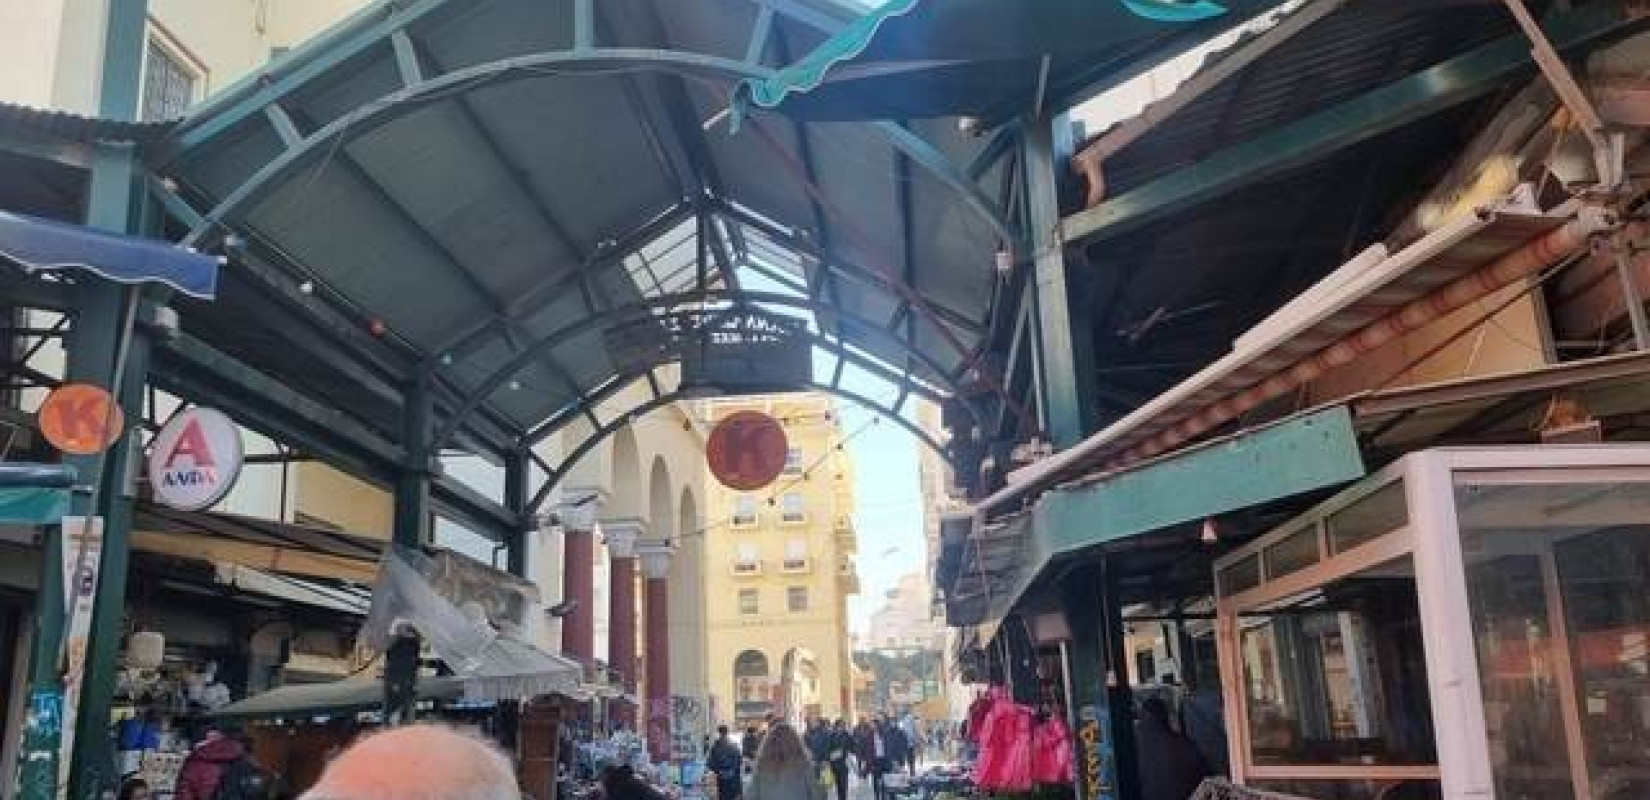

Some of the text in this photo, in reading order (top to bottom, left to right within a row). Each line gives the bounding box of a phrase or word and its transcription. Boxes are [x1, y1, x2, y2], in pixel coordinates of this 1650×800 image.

[54, 397, 107, 439] K
[164, 414, 216, 467] A
[722, 423, 776, 474] K
